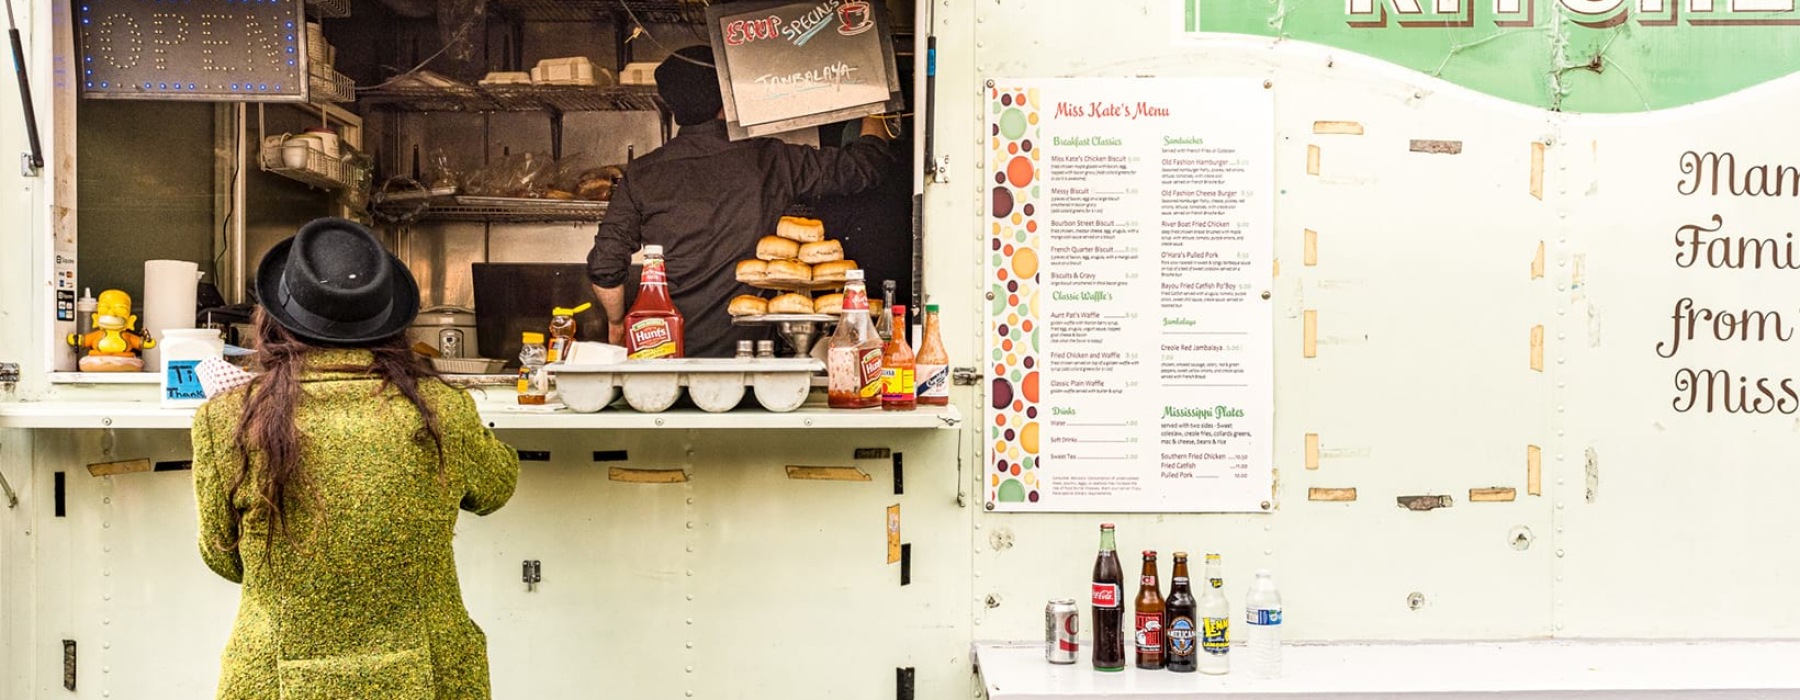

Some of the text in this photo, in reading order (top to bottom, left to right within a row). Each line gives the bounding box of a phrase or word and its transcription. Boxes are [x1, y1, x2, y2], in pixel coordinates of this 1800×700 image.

[726, 0, 840, 46] SOUP SPECIALS
[100, 13, 280, 72] OPEN
[1054, 102, 1170, 119] Miss Kate's Menu
[1053, 136, 1122, 147] Breakfast Classics
[1163, 135, 1203, 146] Sandwiches
[1196, 159, 1228, 167] Hamburger
[1218, 190, 1237, 198] Burger
[1675, 213, 1800, 270] Fami
[1079, 272, 1096, 280] Gravy
[1161, 283, 1179, 291] Bayou
[1216, 283, 1236, 291] Po'Boy
[1052, 290, 1113, 302] Classic Waffle's
[1163, 317, 1196, 326] Jambalaya
[1656, 297, 1794, 359] from
[1193, 344, 1223, 352] Jambalaya
[169, 365, 200, 384] Ti
[1672, 367, 1799, 414] Miss
[1052, 406, 1076, 415] Drinks
[1161, 405, 1244, 419] Mississippi Plates
